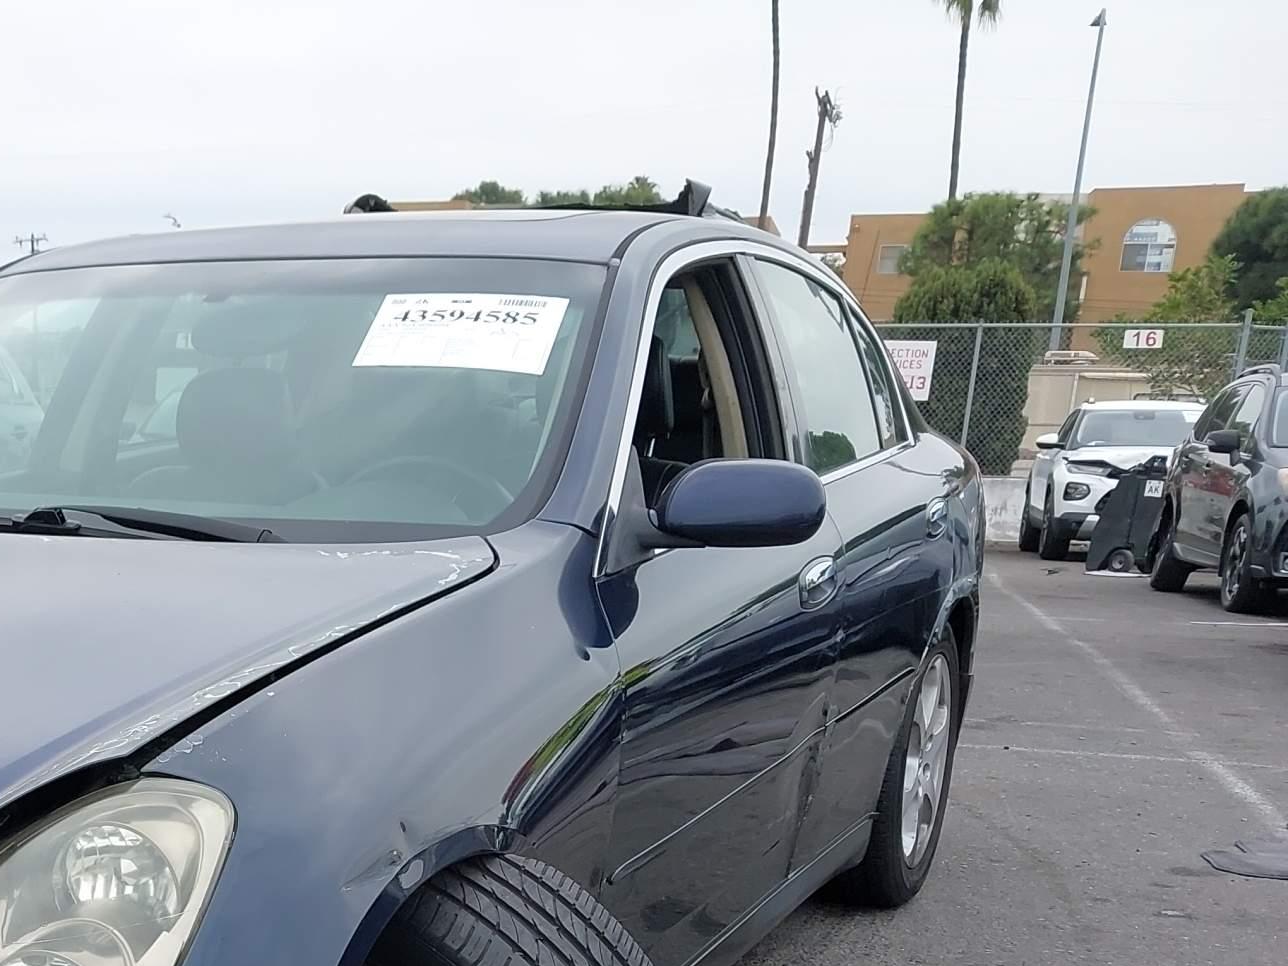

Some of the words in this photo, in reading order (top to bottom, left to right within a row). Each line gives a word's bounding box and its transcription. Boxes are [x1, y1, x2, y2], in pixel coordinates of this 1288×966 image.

[393, 309, 540, 326] 43594585
[1132, 331, 1158, 347] 16
[890, 348, 929, 358] ECTION
